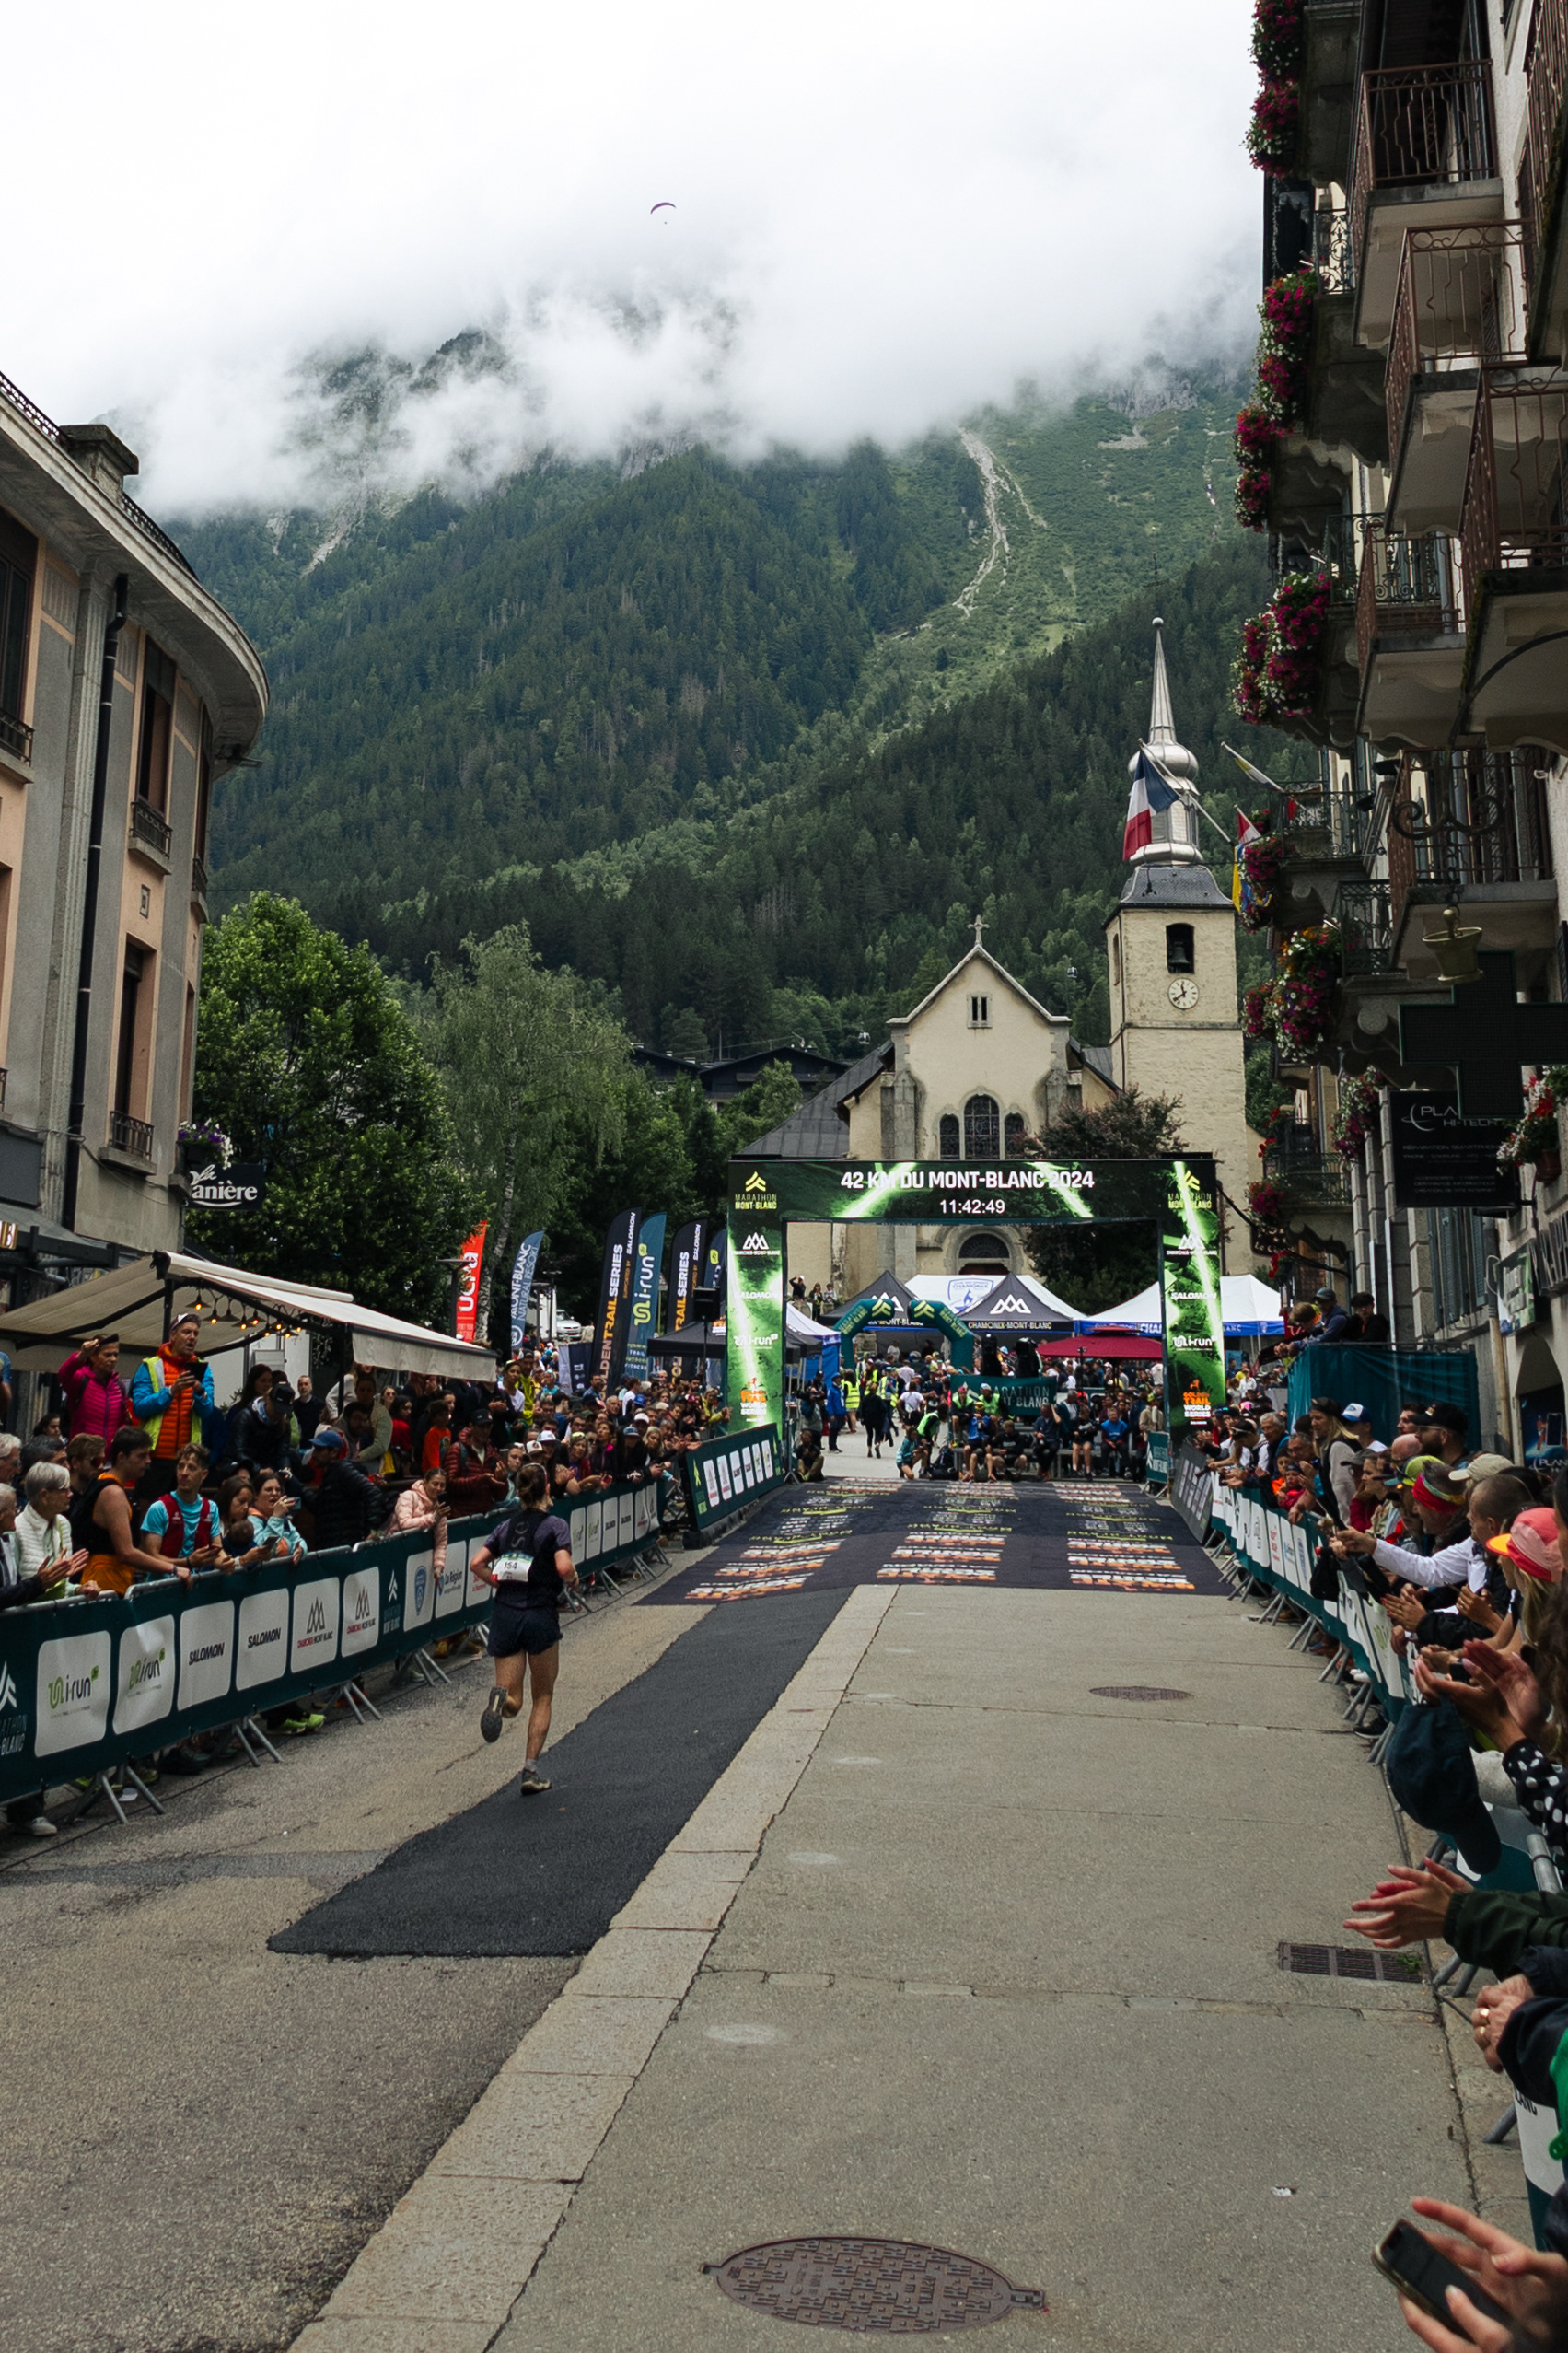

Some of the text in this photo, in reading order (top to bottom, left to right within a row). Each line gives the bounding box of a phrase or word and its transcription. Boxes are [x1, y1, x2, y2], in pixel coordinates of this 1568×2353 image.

[1421, 1106, 1458, 1117] PLA
[841, 1171, 1095, 1189] 42 KM DU MONT-BLANC 2024
[940, 1199, 1005, 1215] 11:42:49
[626, 1212, 636, 1255] SALOMON
[994, 1385, 1050, 1397] ARATHON
[247, 1626, 282, 1649] SALOMON
[189, 1641, 226, 1667] SALOMON
